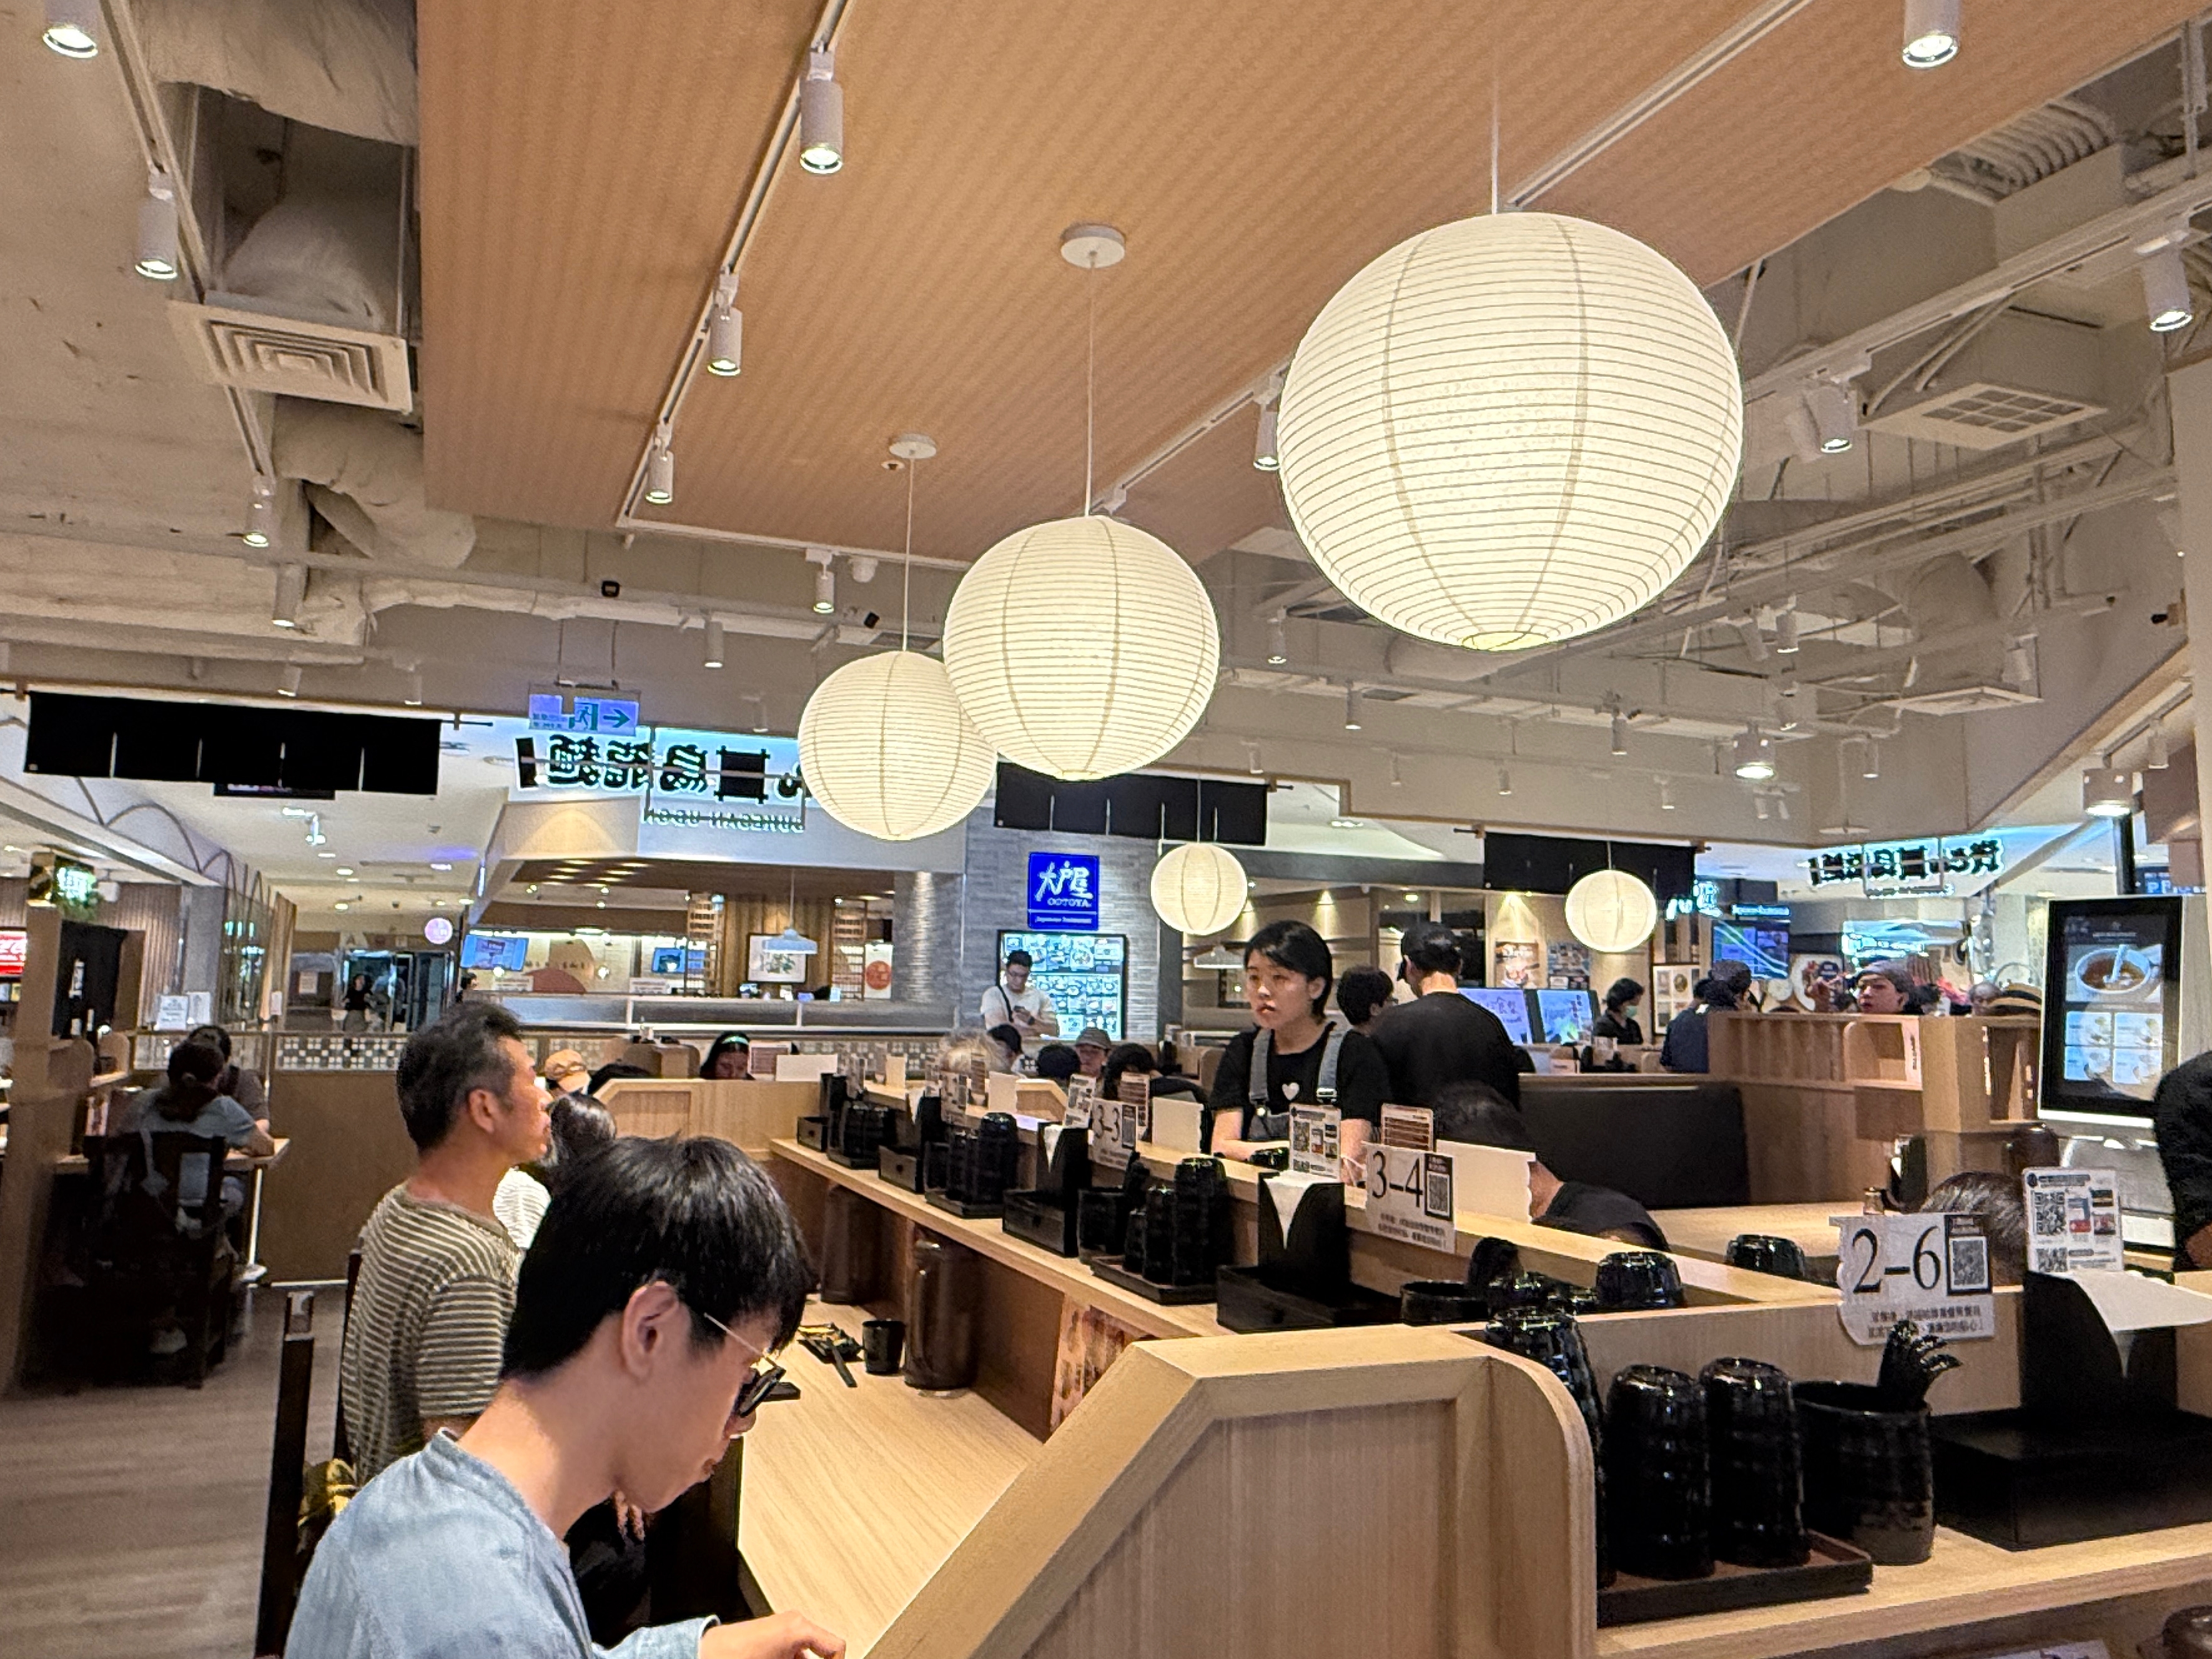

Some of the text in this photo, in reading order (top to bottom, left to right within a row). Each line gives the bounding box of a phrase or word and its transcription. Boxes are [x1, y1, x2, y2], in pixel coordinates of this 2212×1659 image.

[1094, 1104, 1120, 1142] 3-3
[1372, 1151, 1423, 1208] 3-4
[1852, 1226, 1942, 1294] 2-6
